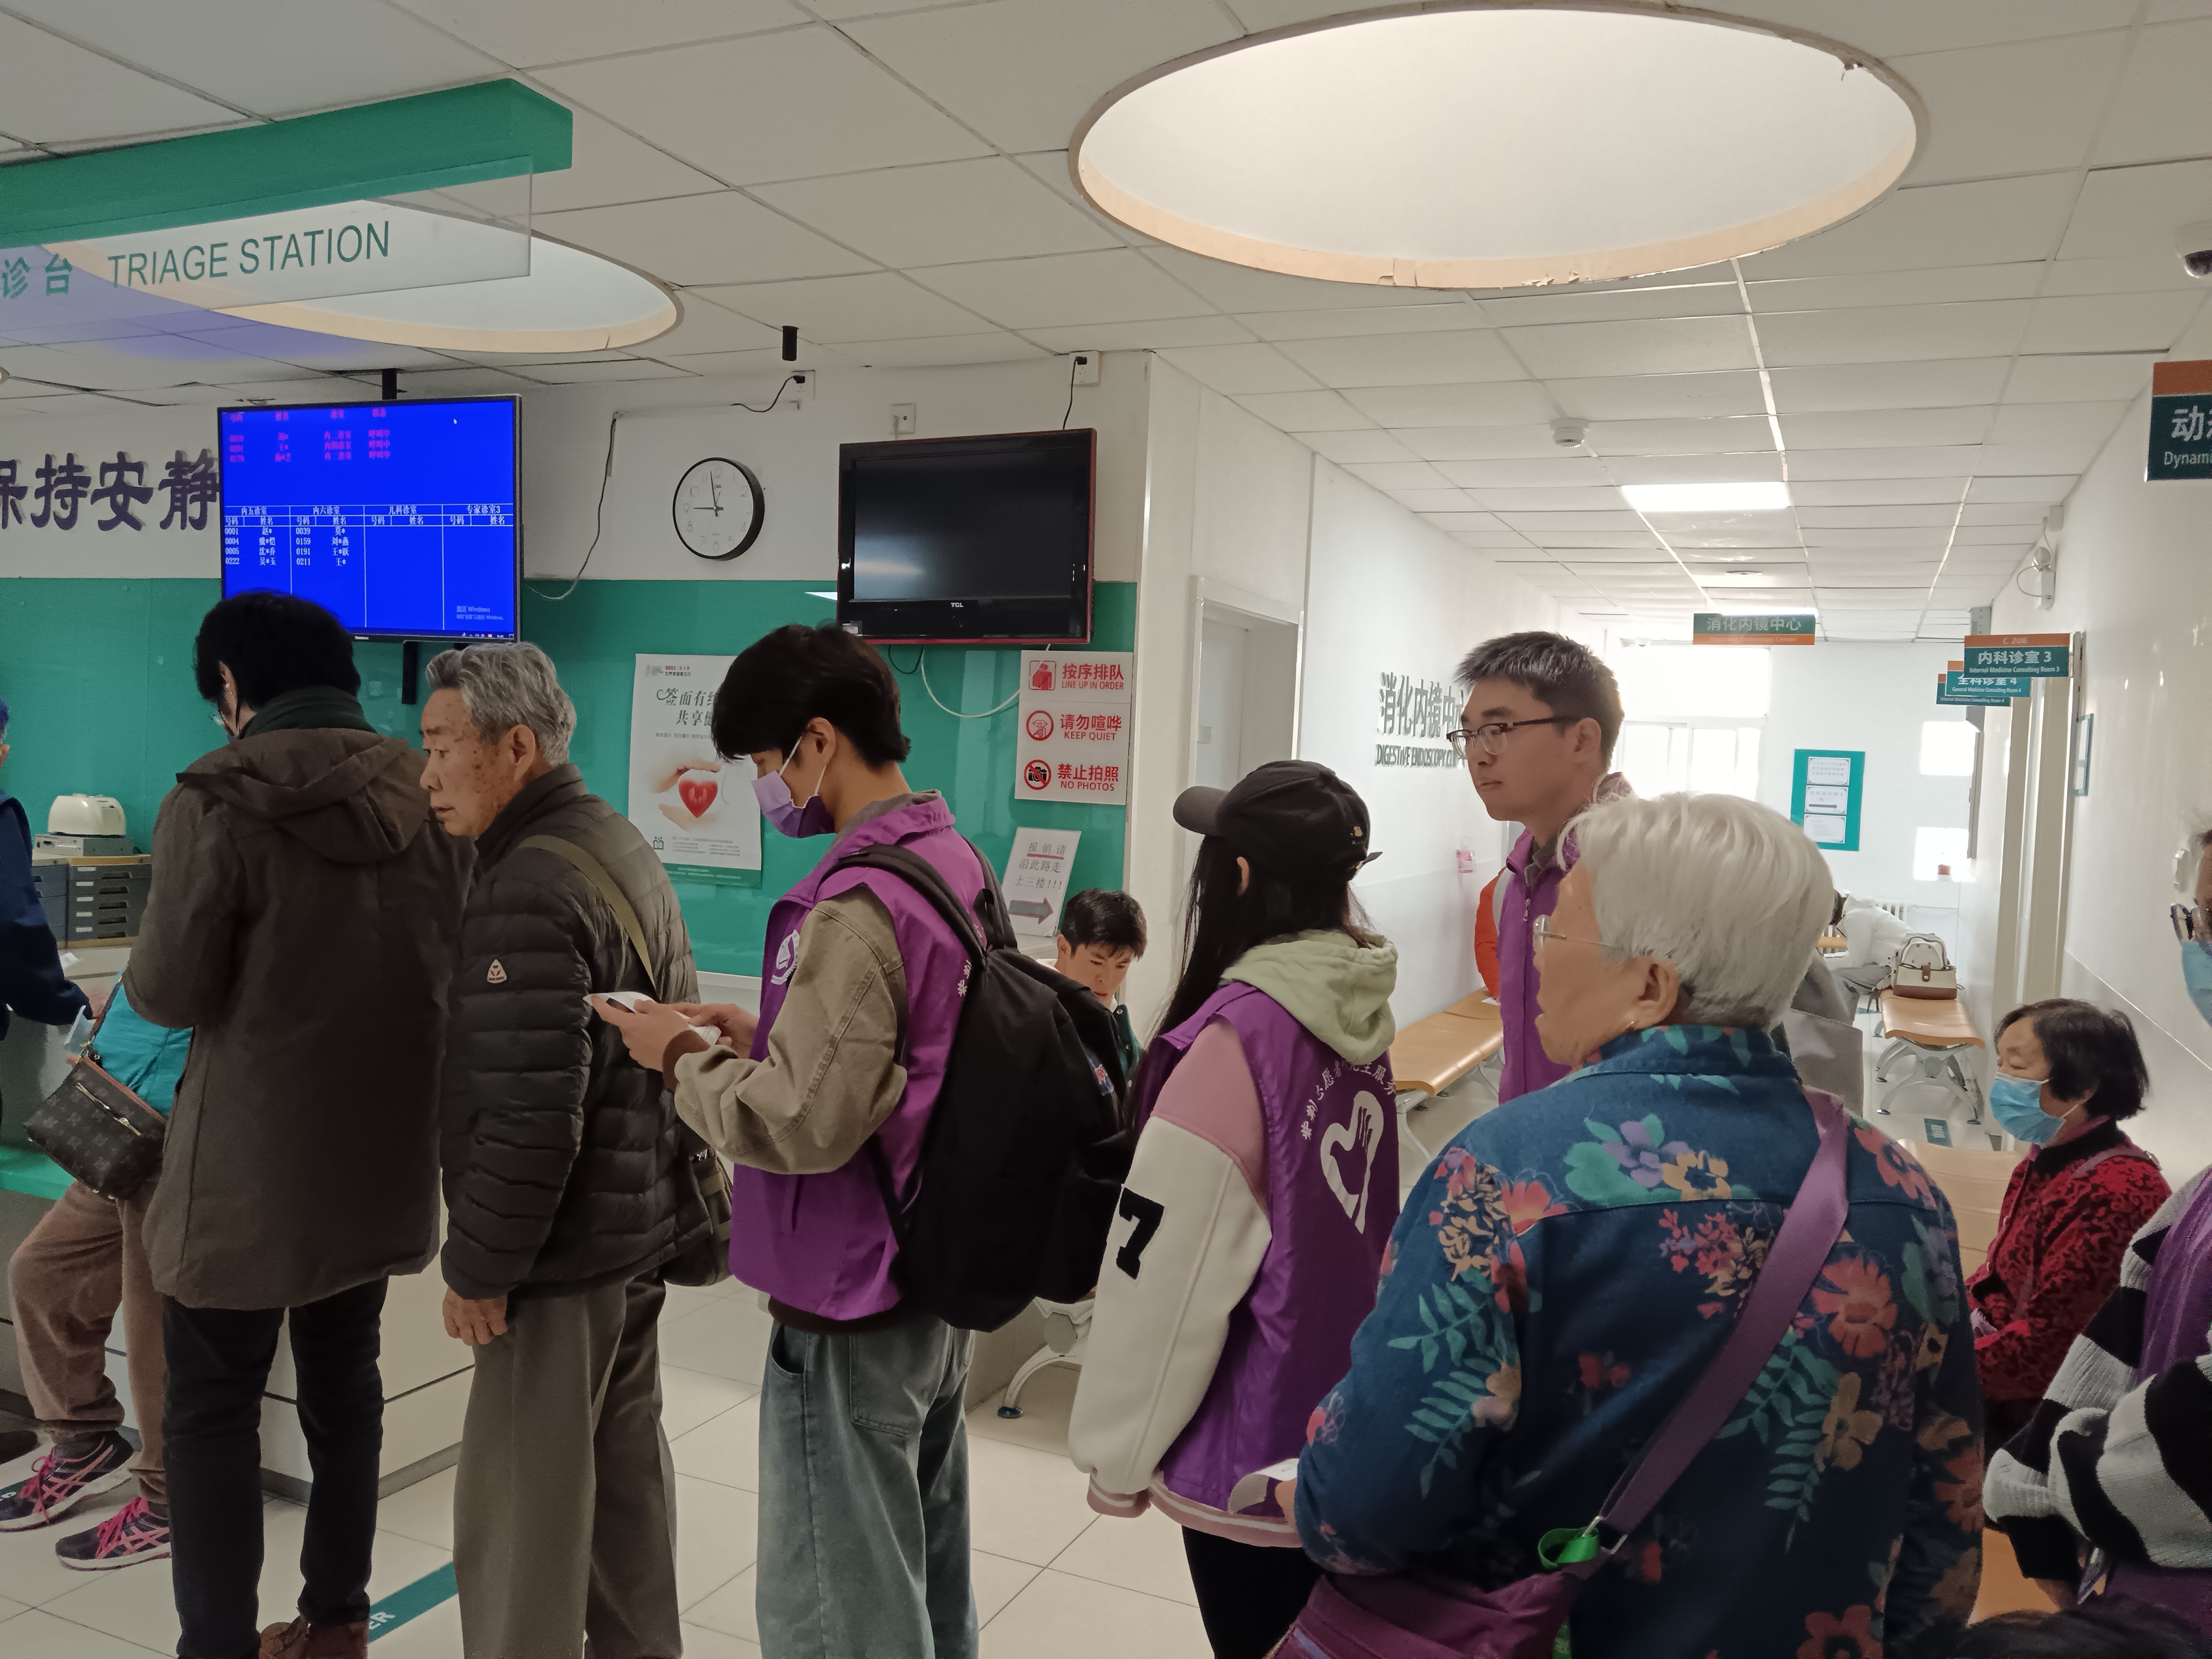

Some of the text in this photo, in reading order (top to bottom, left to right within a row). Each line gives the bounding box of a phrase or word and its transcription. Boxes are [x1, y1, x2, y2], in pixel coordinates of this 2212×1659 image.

[108, 221, 390, 288] TRIAGE STATION
[2, 253, 73, 299] 诊台
[2171, 405, 2212, 442] 动
[702, 472, 707, 483] 11
[715, 467, 723, 478] 12
[690, 486, 699, 497] 10
[742, 486, 748, 497] 2
[241, 506, 268, 515] 内五诊室
[313, 506, 340, 515] 内六诊室
[389, 505, 417, 515] 儿科诊室
[466, 504, 501, 514] 专家诊室3
[683, 503, 689, 514] 9
[225, 516, 238, 525] 号码
[260, 516, 273, 525] 姓名
[297, 516, 310, 525] 号码
[333, 516, 346, 525] 姓名
[371, 516, 385, 525] 号码
[409, 516, 424, 525] 姓名
[450, 516, 464, 525] 号码
[490, 516, 505, 525] 姓名
[687, 521, 693, 532] 8
[741, 522, 746, 532] 4
[225, 537, 239, 545] 0004
[713, 540, 719, 551] 6
[729, 536, 734, 547] 5
[1707, 617, 1802, 631] 消化内镜中心
[1978, 651, 2052, 665] 内科诊室 3
[1062, 663, 1124, 680] 按序排队
[1061, 681, 1077, 689] LINE
[1079, 681, 1088, 689] UP
[1100, 681, 1124, 690] ORDER
[1060, 714, 1122, 732] 请勿喧哗
[1064, 731, 1116, 741] KEEP QUIET
[1376, 744, 1411, 766] DIGESTIVE
[1412, 747, 1447, 767] ENDOSCOPY
[1057, 763, 1119, 782] 禁止拍照
[1061, 781, 1114, 791] NO PHOTOS
[1028, 842, 1066, 856] 报销请
[1019, 858, 1061, 873] 沿此路走
[1116, 1187, 1165, 1280] 7
[368, 1611, 396, 1630] ER
